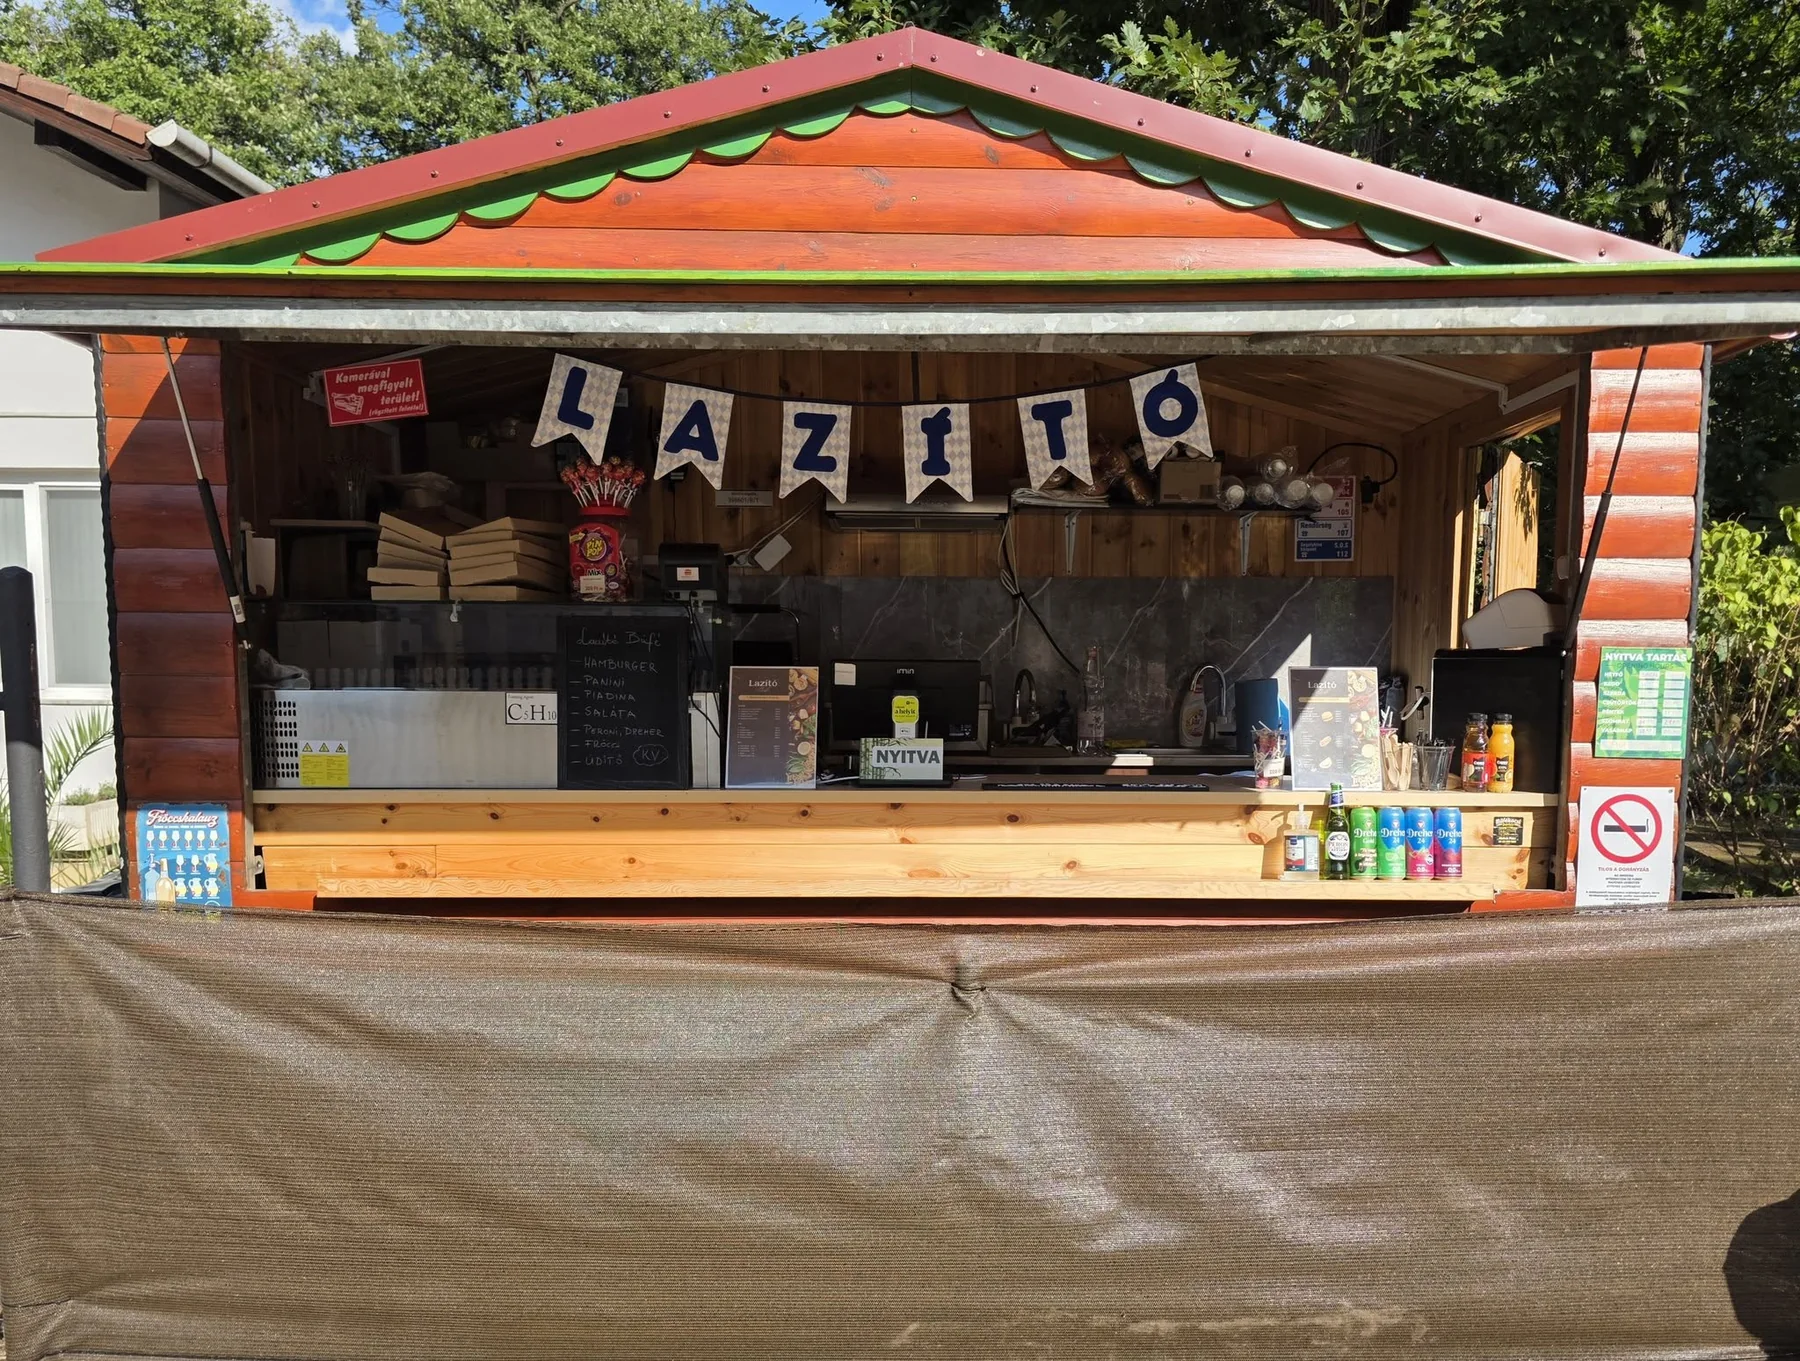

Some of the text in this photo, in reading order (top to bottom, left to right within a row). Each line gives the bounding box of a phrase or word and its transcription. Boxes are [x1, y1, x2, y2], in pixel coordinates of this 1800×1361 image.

[335, 367, 391, 384] Kamerával
[357, 377, 414, 394] megfigyelt
[380, 391, 420, 405] terület!
[557, 366, 1200, 476] LAZÍTÓ
[1605, 651, 1688, 662] NYITVA TARTÁS
[584, 656, 658, 674] HAMBURGER
[583, 674, 625, 688] PANINI
[748, 679, 778, 688] Lazító
[1308, 680, 1337, 689] Lazító
[583, 690, 636, 702] PIADINA
[584, 705, 636, 719] SALÁTA
[625, 726, 665, 738] DREHER
[642, 750, 661, 762] KV
[876, 749, 941, 765] NYITVA
[146, 809, 219, 828] Fröccskalauz
[1380, 828, 1406, 838] Drehe
[1406, 828, 1434, 838] Drehe
[1436, 828, 1462, 838] Drehe
